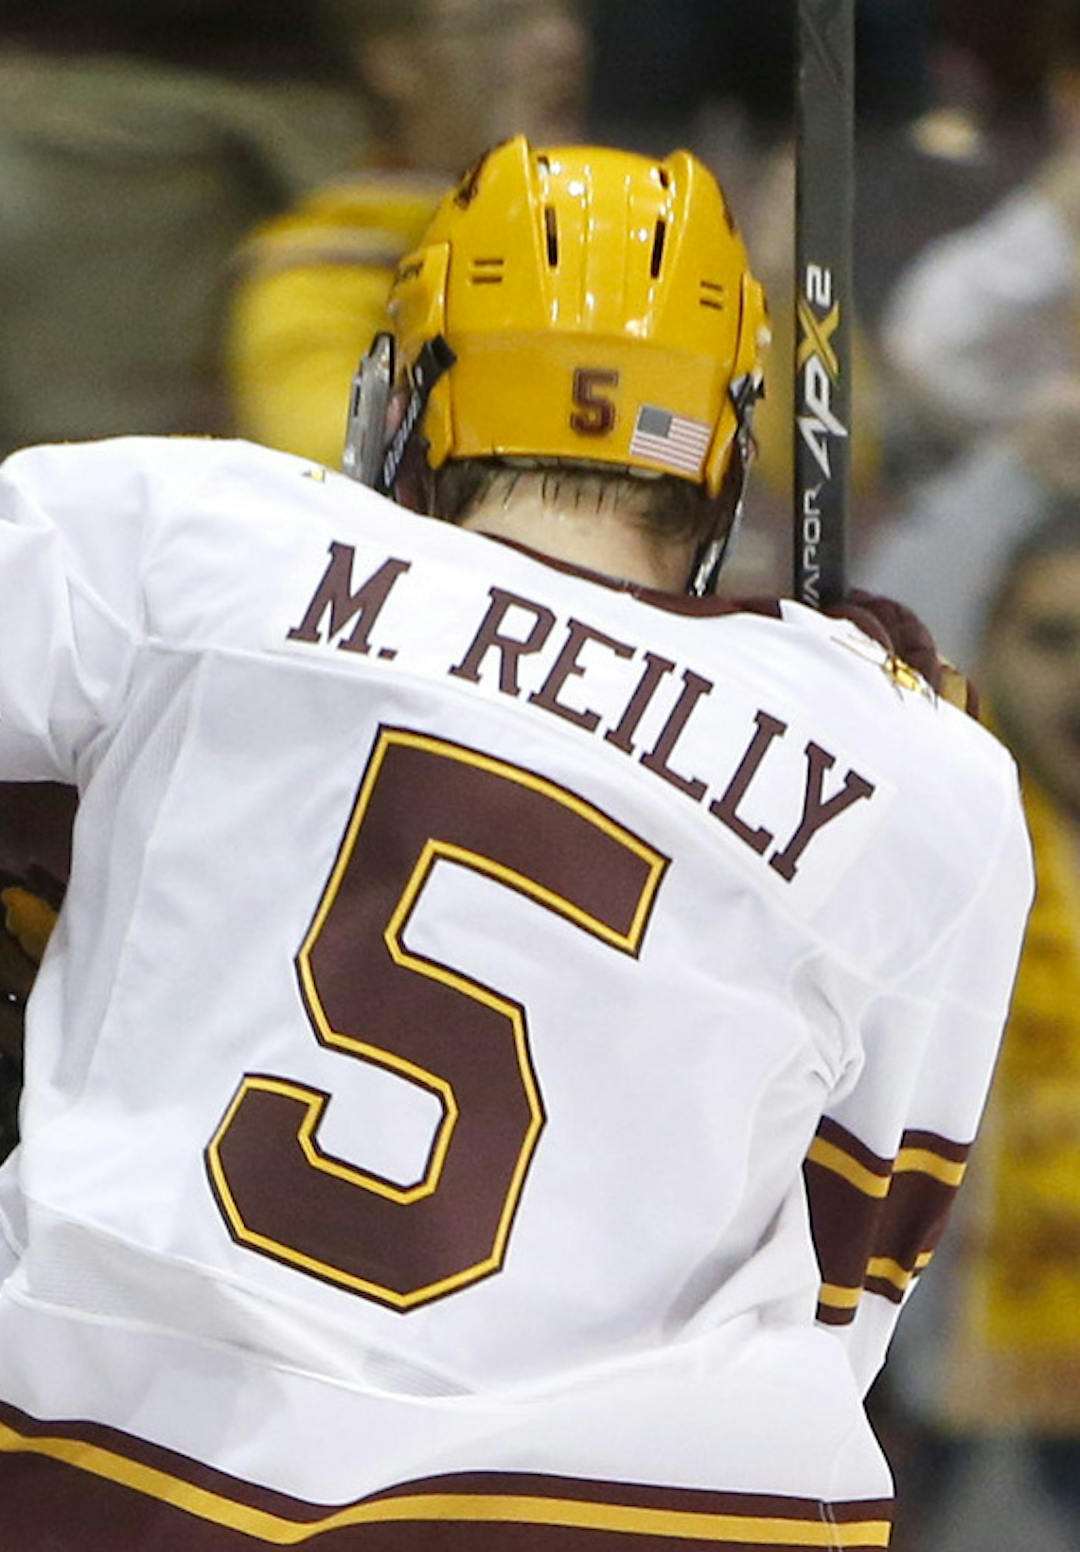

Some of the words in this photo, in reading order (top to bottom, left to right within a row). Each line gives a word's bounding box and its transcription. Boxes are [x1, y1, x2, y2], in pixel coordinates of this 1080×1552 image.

[570, 367, 619, 438] 5
[797, 263, 848, 480] APX2
[286, 541, 411, 660] M.
[448, 586, 875, 882] REILLY
[204, 723, 672, 1314] 5
